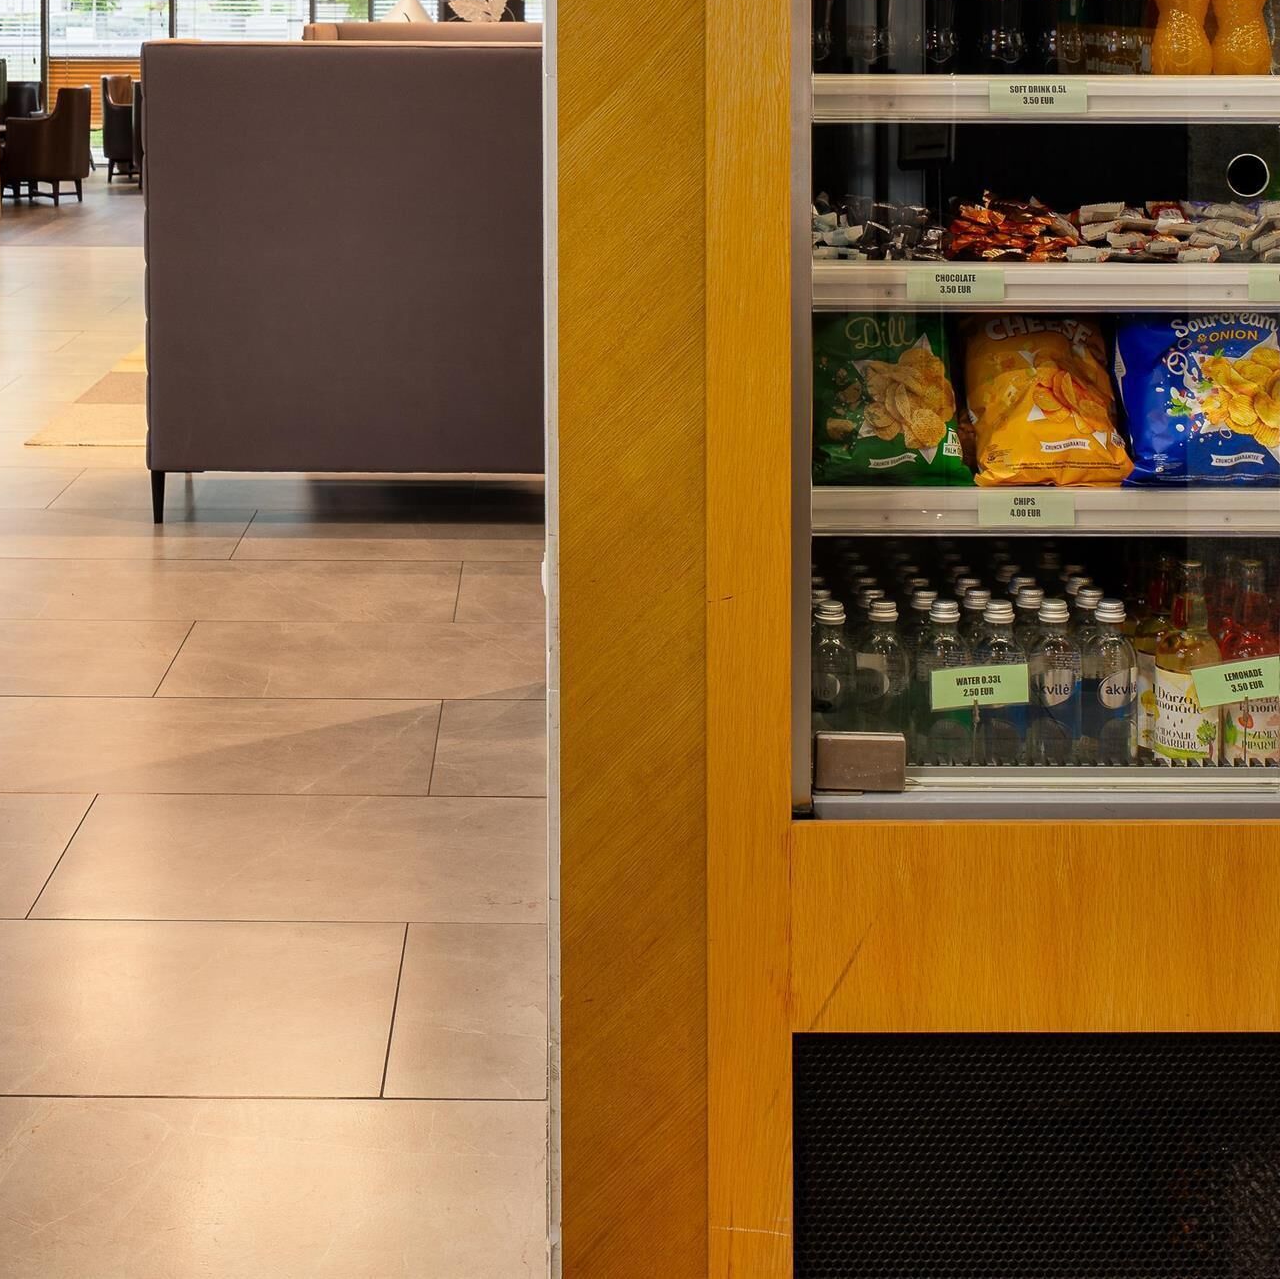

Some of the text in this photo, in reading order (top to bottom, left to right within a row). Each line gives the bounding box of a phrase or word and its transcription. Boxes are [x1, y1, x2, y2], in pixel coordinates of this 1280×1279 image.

[1009, 85, 1067, 93] SOFT DRINK 0.5L
[1023, 96, 1054, 104] 3.50 EUR
[935, 274, 976, 282] CHOCOLATE
[940, 285, 971, 294] 3.50 EUR
[1170, 312, 1279, 338] Sour cream
[845, 317, 915, 349] Dill
[985, 315, 1094, 346] CHEESE
[1197, 330, 1258, 343] & ONION
[1013, 498, 1035, 506] CHIPS
[1010, 509, 1041, 517] 4.00 EUR
[1224, 668, 1263, 682] LEMONADE
[956, 675, 1001, 686] WATER 0.33L
[1231, 680, 1264, 693] 3.50 EUR
[963, 687, 994, 697] 2.50 EUR
